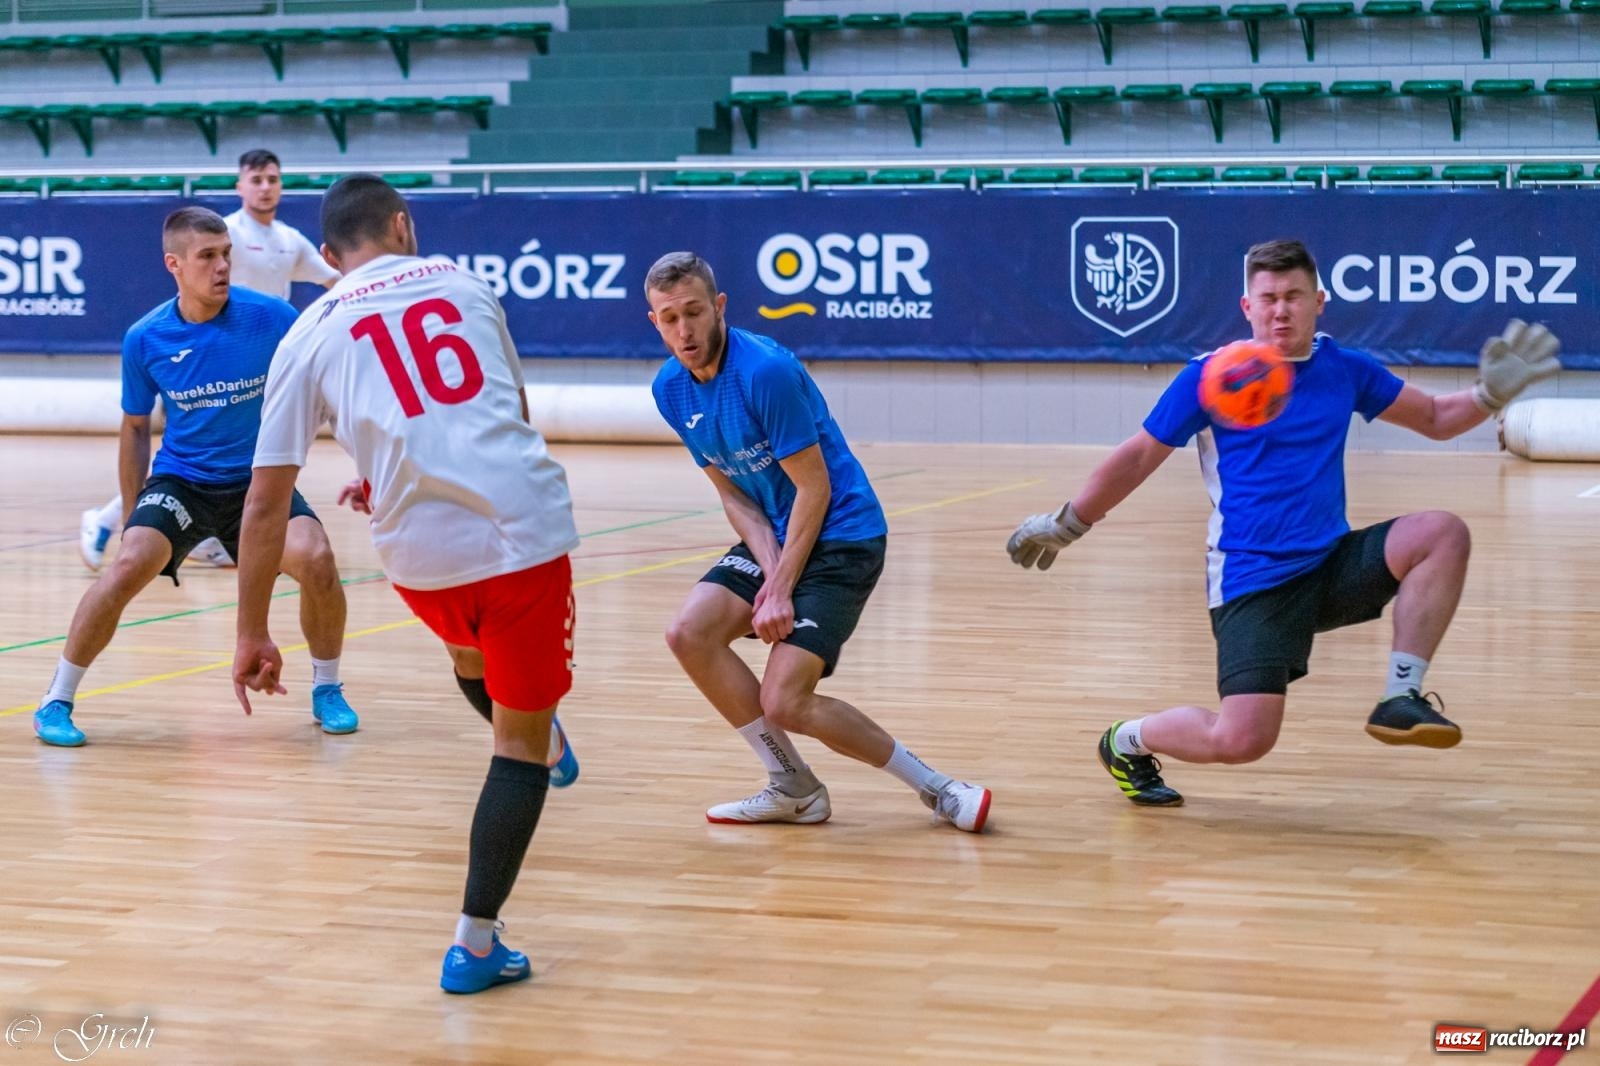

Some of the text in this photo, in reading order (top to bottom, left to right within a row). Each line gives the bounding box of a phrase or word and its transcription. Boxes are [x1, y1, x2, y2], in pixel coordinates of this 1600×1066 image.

[426, 238, 628, 300] BÓRZ
[756, 233, 933, 296] OSiR
[1243, 237, 1578, 304] CIBÓRZ
[825, 296, 933, 320] RACIBÓRZ
[349, 297, 485, 420] 16
[161, 495, 194, 532] SPORT
